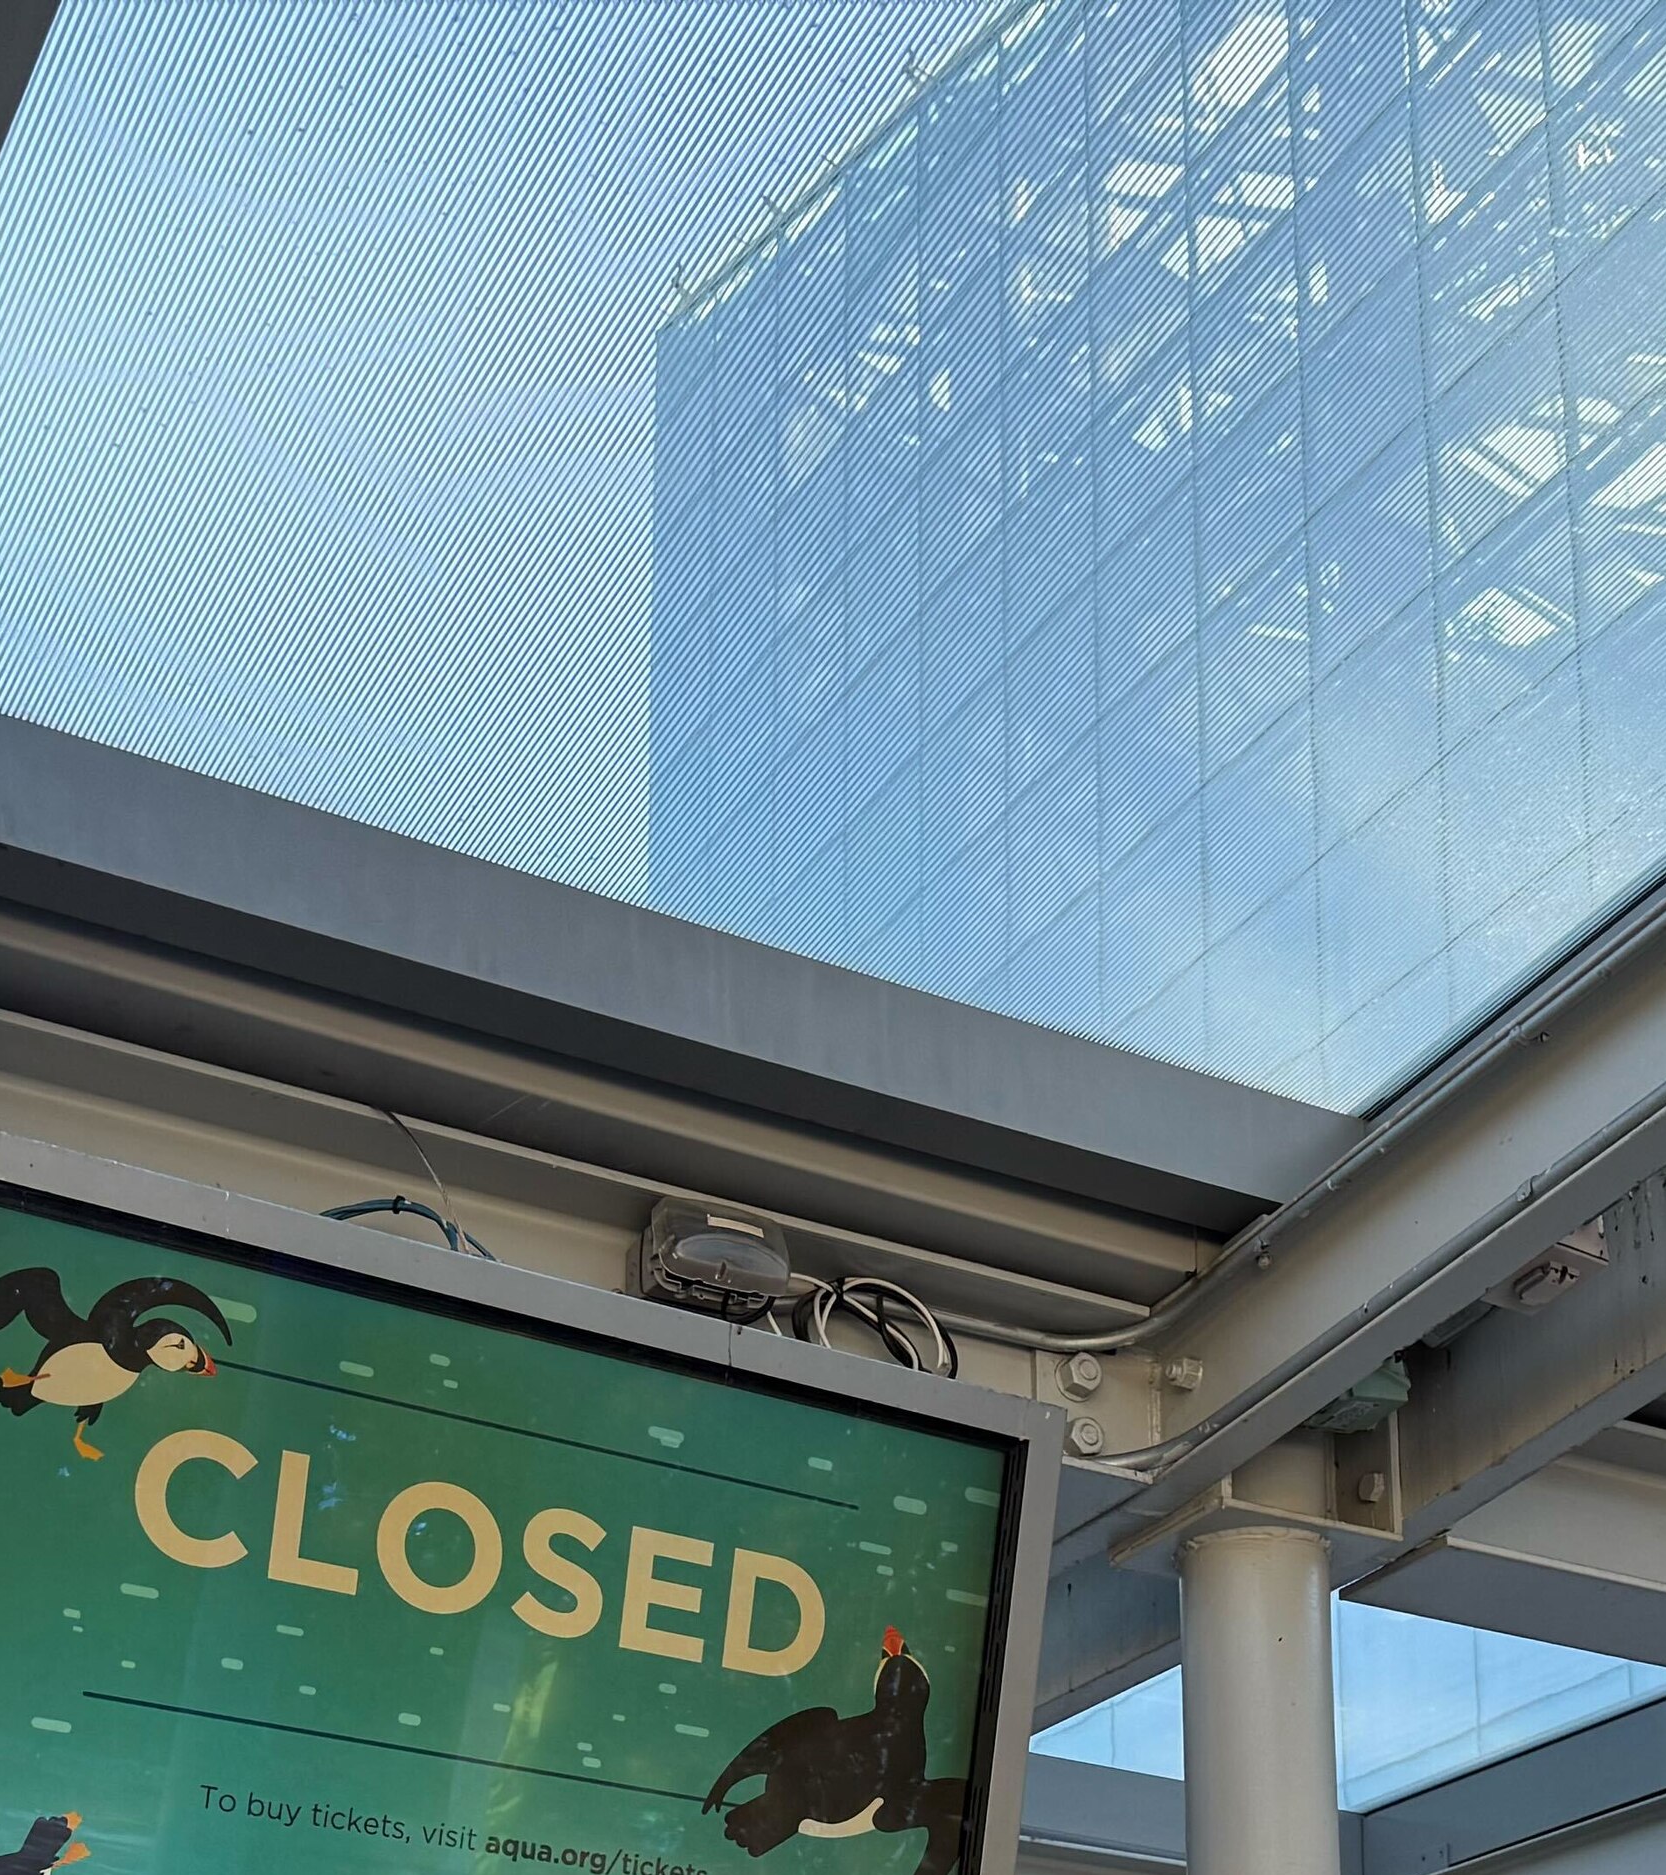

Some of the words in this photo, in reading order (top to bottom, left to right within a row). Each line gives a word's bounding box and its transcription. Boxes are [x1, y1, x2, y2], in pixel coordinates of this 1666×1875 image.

[133, 1429, 826, 1678] CLOSED
[200, 1784, 237, 1813] To
[246, 1791, 302, 1828] buy
[311, 1803, 411, 1844] tickets,
[421, 1822, 478, 1851] visit
